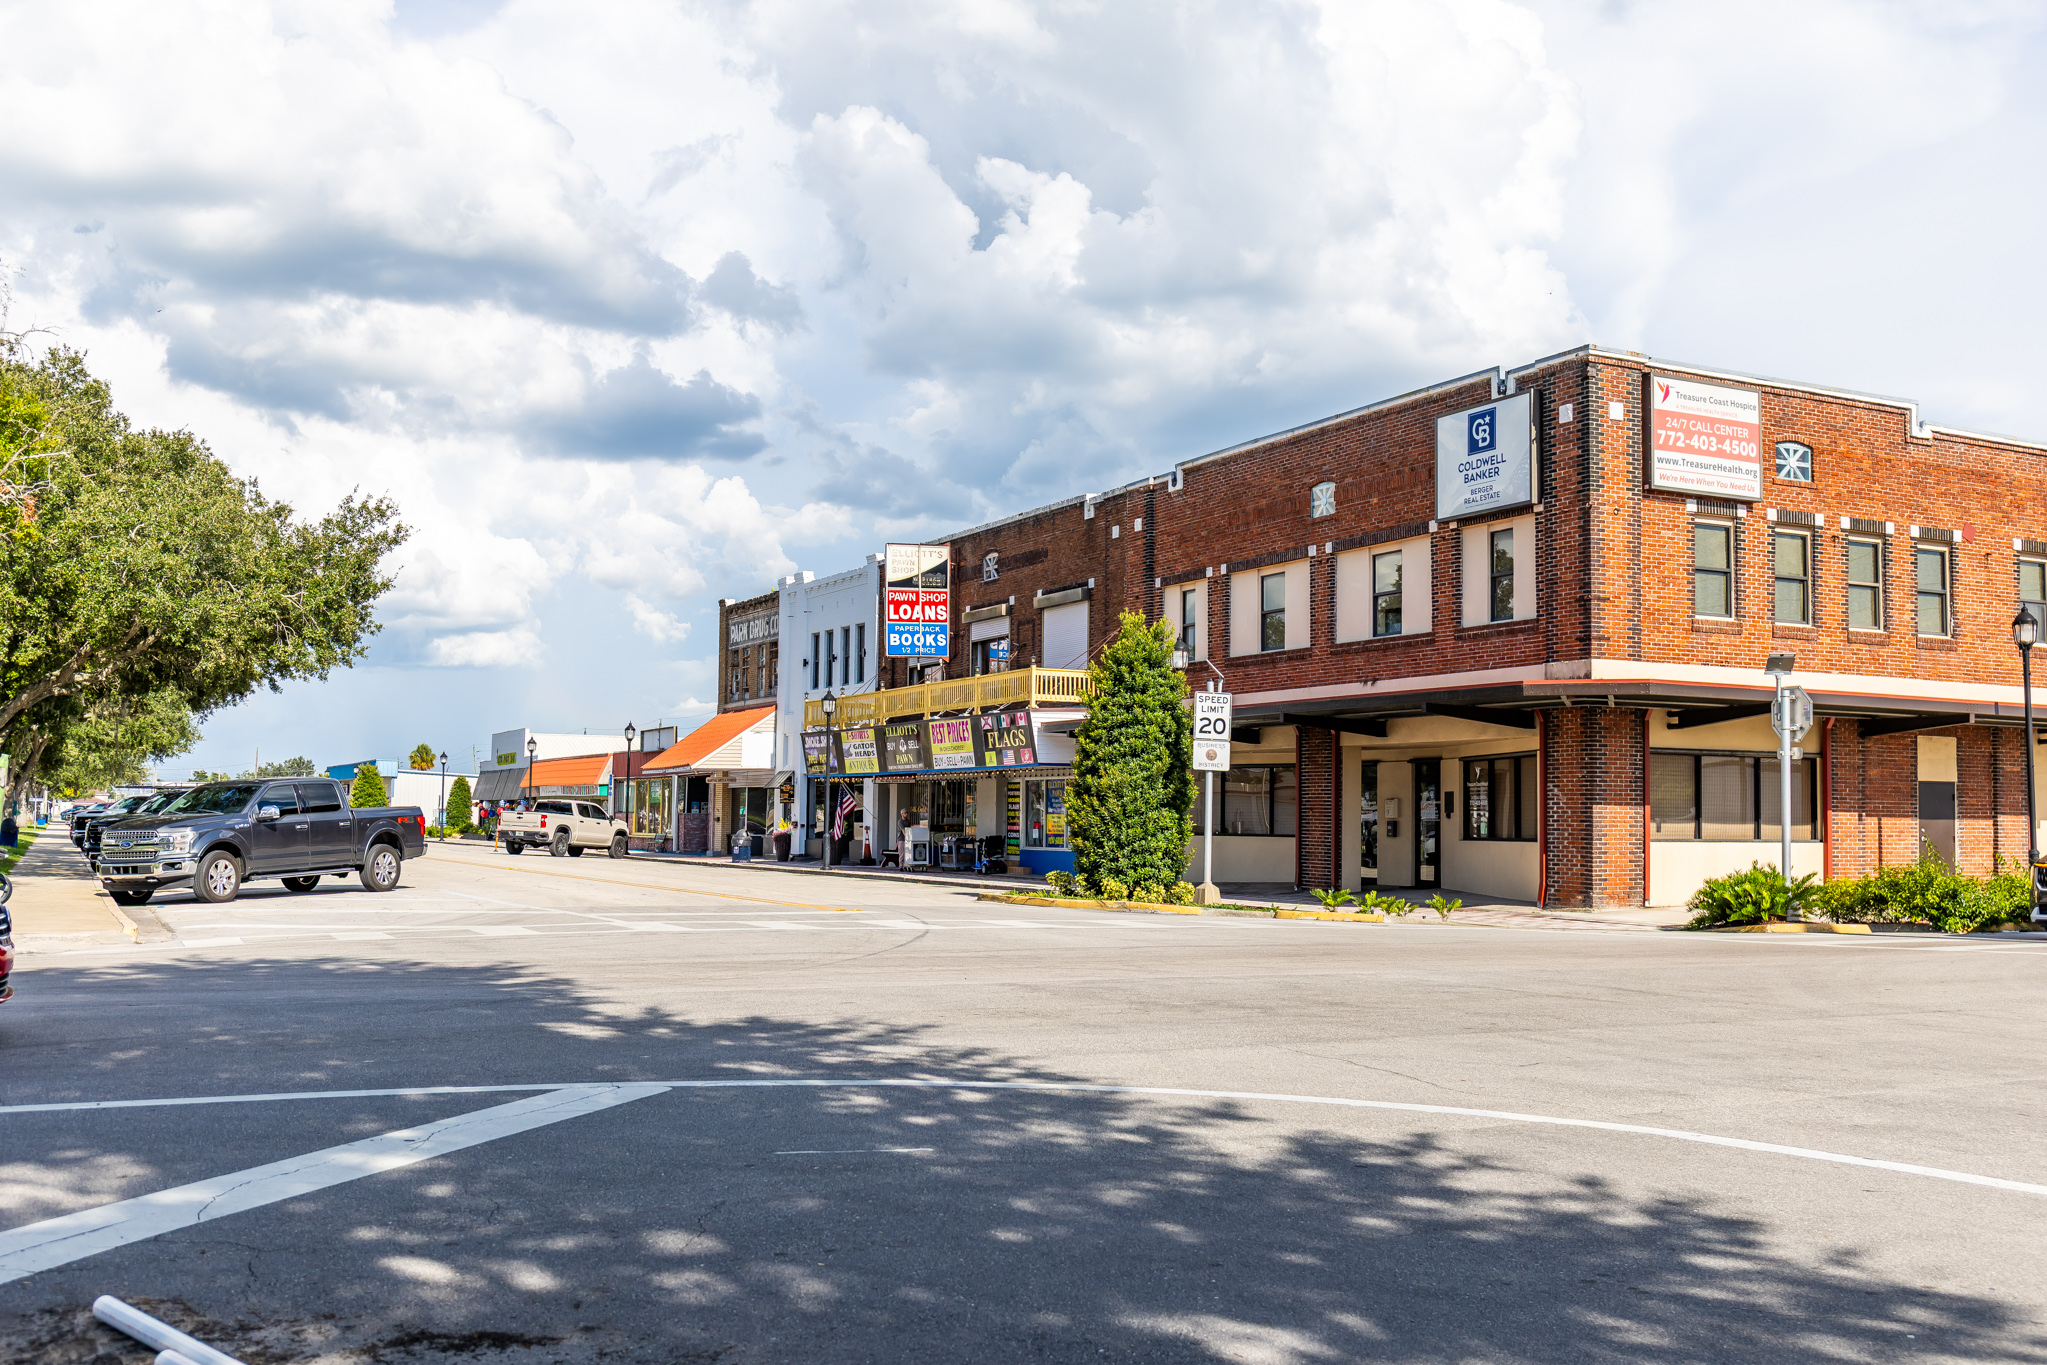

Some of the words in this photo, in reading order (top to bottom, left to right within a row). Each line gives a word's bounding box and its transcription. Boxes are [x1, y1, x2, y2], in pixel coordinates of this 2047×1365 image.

[1676, 391, 1708, 404] Treasure
[1708, 396, 1729, 407] Coast
[1730, 400, 1757, 412] Hospice
[1665, 417, 1688, 430] 24/7
[1689, 420, 1713, 434] CALL
[1713, 423, 1749, 439] CENTER
[1657, 429, 1757, 458] 772-403-4500
[1458, 452, 1507, 473] COLDWELL
[1656, 456, 1758, 479] www.TreasureHealth.org
[1464, 466, 1500, 484] BANKER
[1471, 485, 1493, 495] BERGER
[1659, 473, 1678, 483] We're
[1679, 475, 1695, 485] Here
[1696, 477, 1715, 487] When
[1715, 480, 1729, 489] You
[1730, 482, 1747, 491] Need
[1747, 484, 1756, 493] Us
[1463, 496, 1479, 505] REAL
[1480, 490, 1501, 502] ESTATE
[892, 559, 916, 567] PAWN
[889, 592, 916, 602] PAWN
[920, 593, 947, 603] SHOP
[889, 604, 947, 621] LOANS
[730, 623, 748, 644] PARK
[749, 618, 769, 639] DRUG
[889, 633, 947, 647] BOOKS
[1198, 695, 1228, 704] SPEED
[1201, 705, 1224, 713] LIMIT
[885, 724, 918, 738] ELLIOTT'S
[931, 722, 946, 745] BEST
[946, 720, 971, 744] PRICES
[1199, 717, 1226, 735] 20
[845, 730, 870, 741] T-SHIRTS
[987, 728, 1027, 749] FLAGS
[852, 742, 875, 750] GATOR
[886, 742, 897, 751] BUY
[907, 740, 920, 749] SELL
[854, 750, 876, 758] HEADS
[895, 754, 914, 765] PAWN
[934, 757, 944, 767] BUY
[946, 755, 957, 766] SELL
[959, 754, 974, 764] PAWN
[849, 760, 875, 772] ANTIQUES
